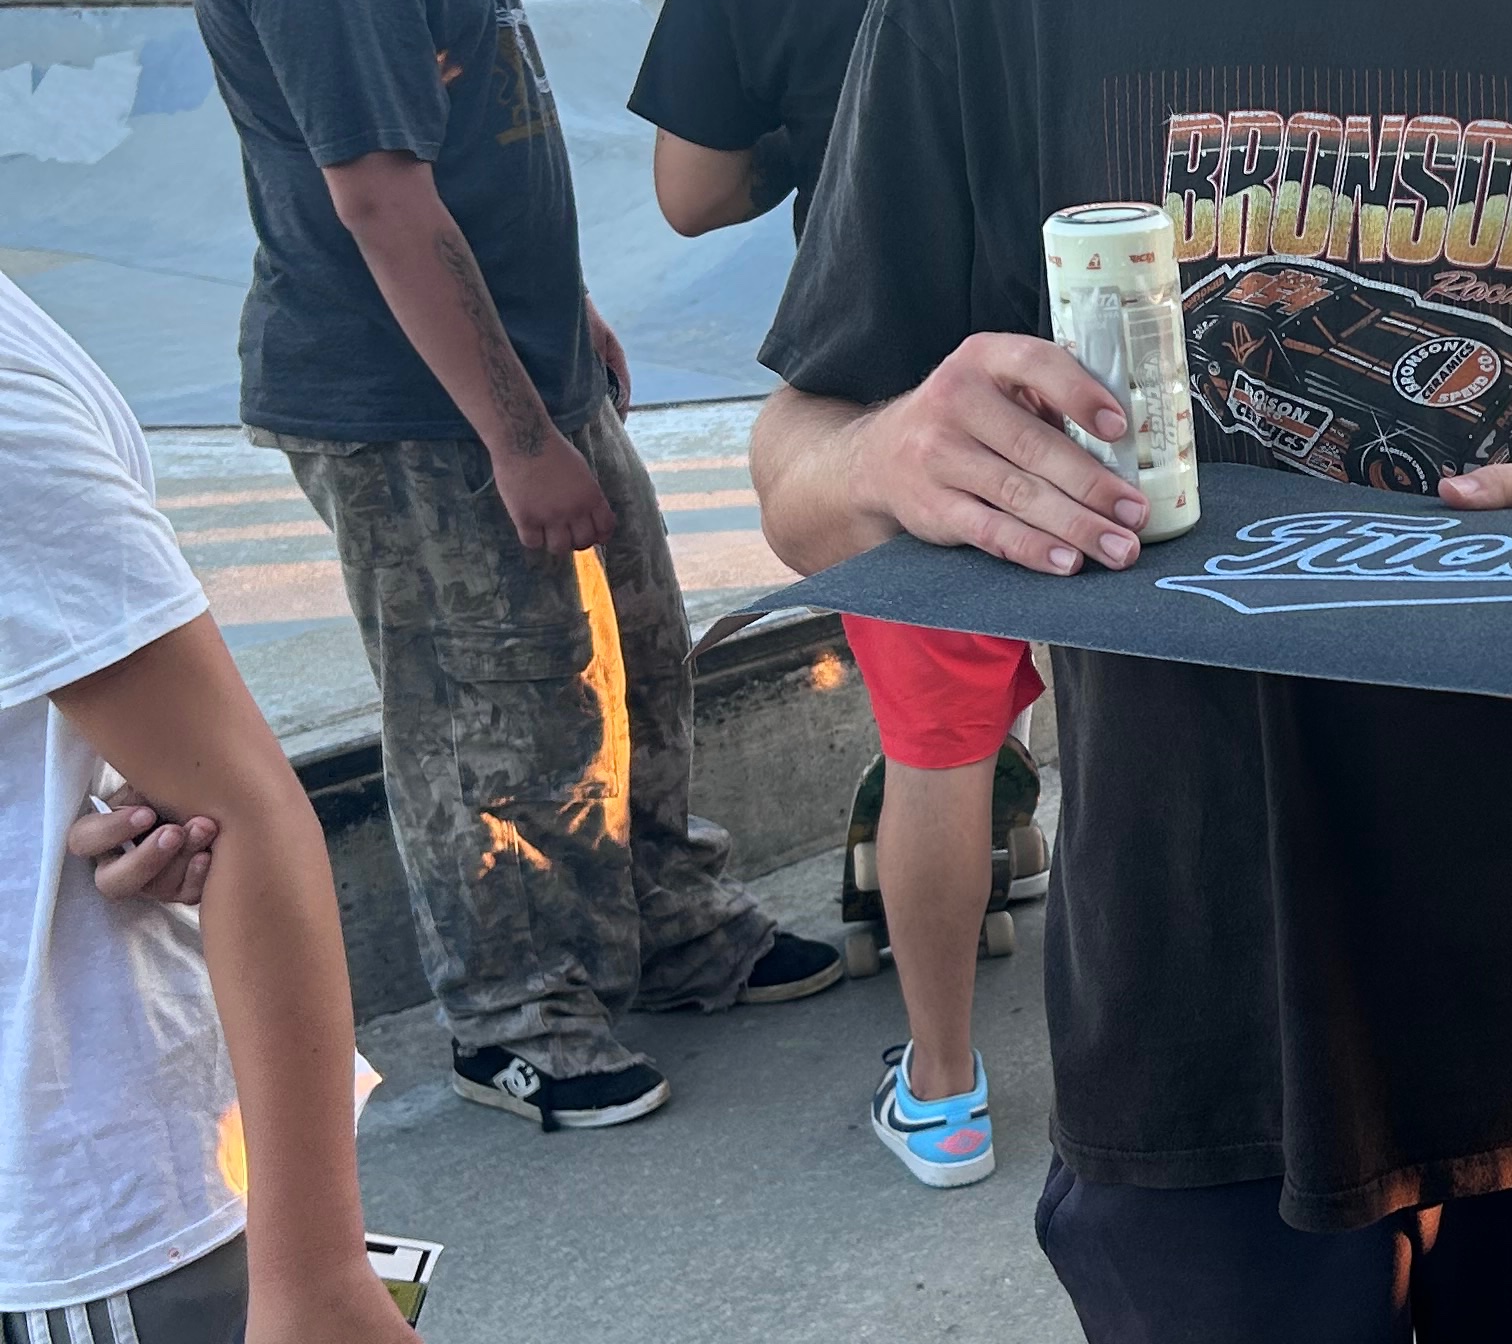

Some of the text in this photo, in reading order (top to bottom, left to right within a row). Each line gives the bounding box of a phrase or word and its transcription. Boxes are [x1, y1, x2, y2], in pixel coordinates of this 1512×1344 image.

[1400, 340, 1460, 394] BRONSON
[1421, 341, 1477, 400] CERAMICS
[1437, 375, 1489, 403] SPEED
